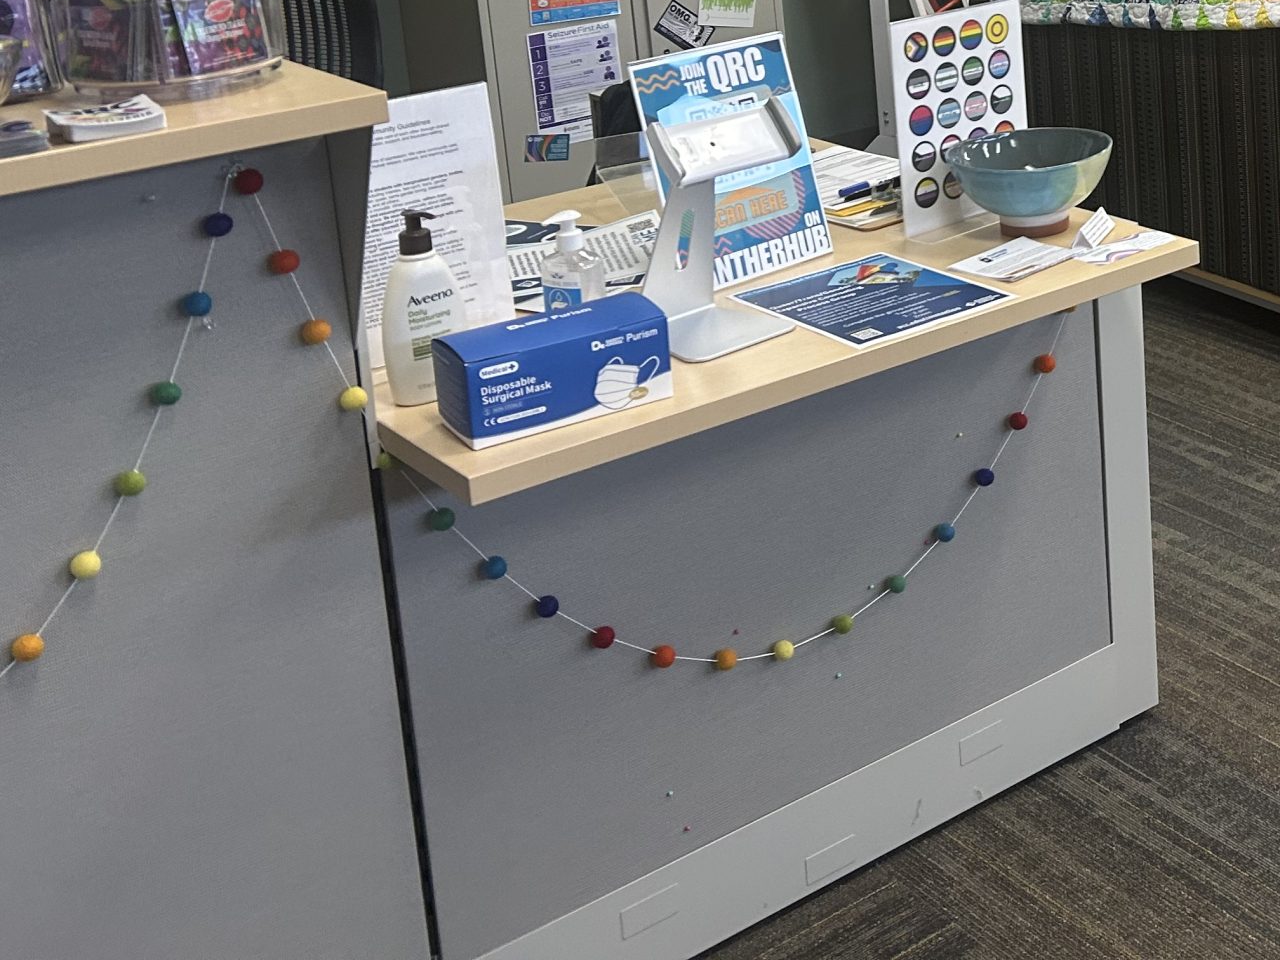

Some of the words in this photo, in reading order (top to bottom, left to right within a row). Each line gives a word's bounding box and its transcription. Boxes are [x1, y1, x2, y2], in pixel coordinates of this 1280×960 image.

[547, 27, 577, 39] Seizure
[577, 25, 595, 33] First
[536, 50, 541, 59] 1
[536, 65, 544, 75] 2
[680, 62, 706, 82] JOIN
[706, 46, 766, 93] QRC
[539, 81, 546, 91] 3
[684, 80, 708, 96] THE
[373, 126, 395, 134] munity
[715, 205, 746, 229] CAN
[752, 190, 788, 215] HERE
[804, 209, 821, 227] ON
[714, 226, 831, 286] NTHERHUB
[407, 288, 454, 307] Aveeno
[408, 310, 428, 318] Daily
[409, 310, 451, 325] Moisturizing
[550, 307, 592, 320] Purism
[626, 328, 658, 343] Purism
[481, 365, 508, 377] Medical
[480, 376, 536, 396] Disposable
[482, 387, 524, 406] Surgical
[525, 380, 552, 394] Mask
